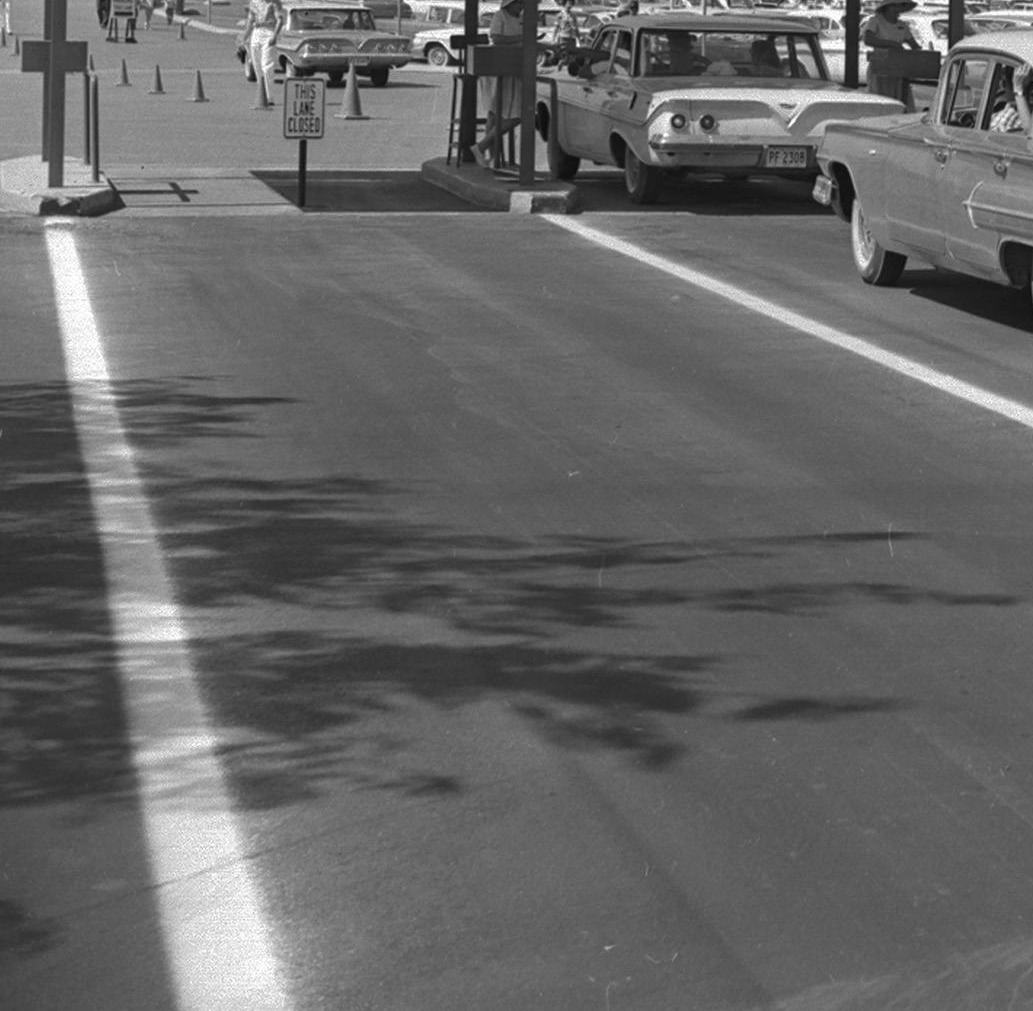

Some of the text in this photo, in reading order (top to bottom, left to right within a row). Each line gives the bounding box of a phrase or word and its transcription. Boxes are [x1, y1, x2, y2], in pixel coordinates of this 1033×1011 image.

[294, 83, 316, 99] THIS
[293, 100, 315, 116] LANE
[288, 116, 321, 133] CLOSED
